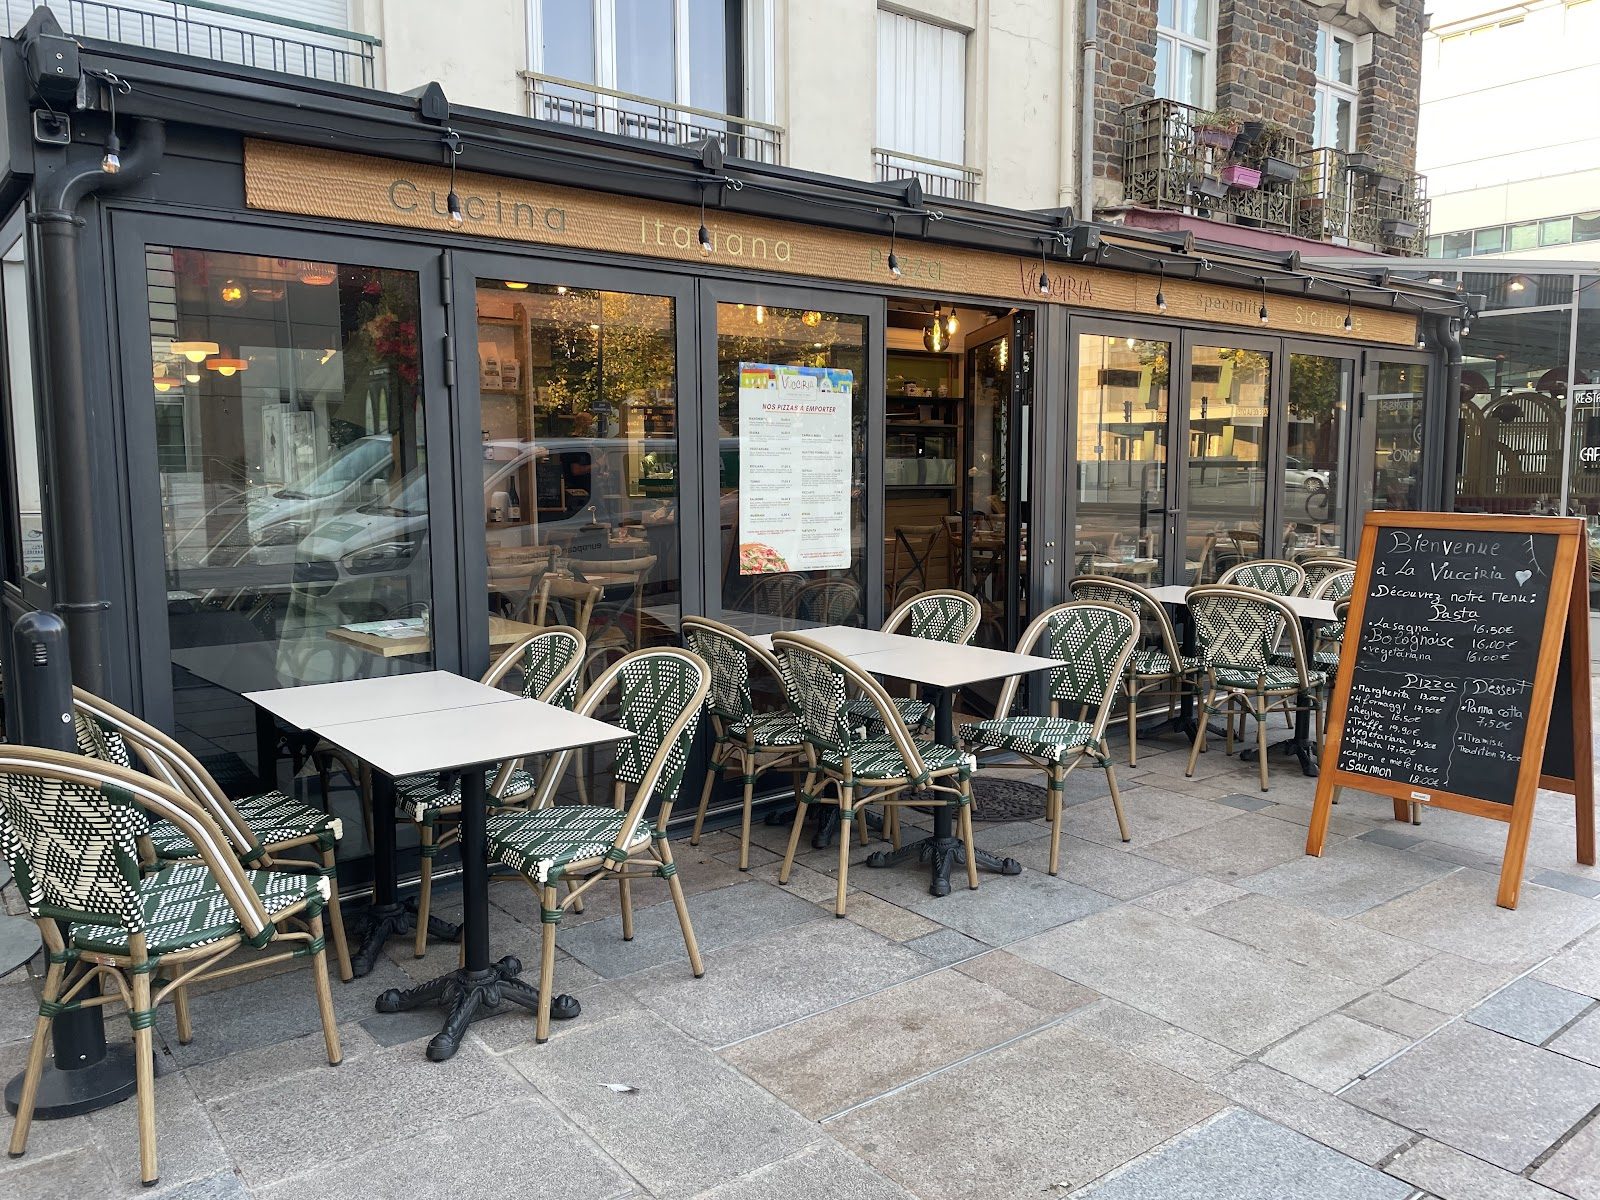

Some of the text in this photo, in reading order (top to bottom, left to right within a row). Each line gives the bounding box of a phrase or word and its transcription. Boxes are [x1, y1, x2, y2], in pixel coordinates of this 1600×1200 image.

[388, 180, 942, 280] Cucina Itaiana Pzza
[805, 405, 837, 413] EMPORTER
[1386, 531, 1500, 556] Bienvenue
[1376, 561, 1389, 577] à
[1375, 584, 1443, 605] Découvrez
[1429, 604, 1480, 621] Pasta
[1472, 679, 1533, 696] Dessert
[1353, 705, 1385, 720] Regina
[1464, 698, 1494, 715] Panna
[1350, 716, 1384, 731] Truffe
[1345, 759, 1392, 777] Saumon
